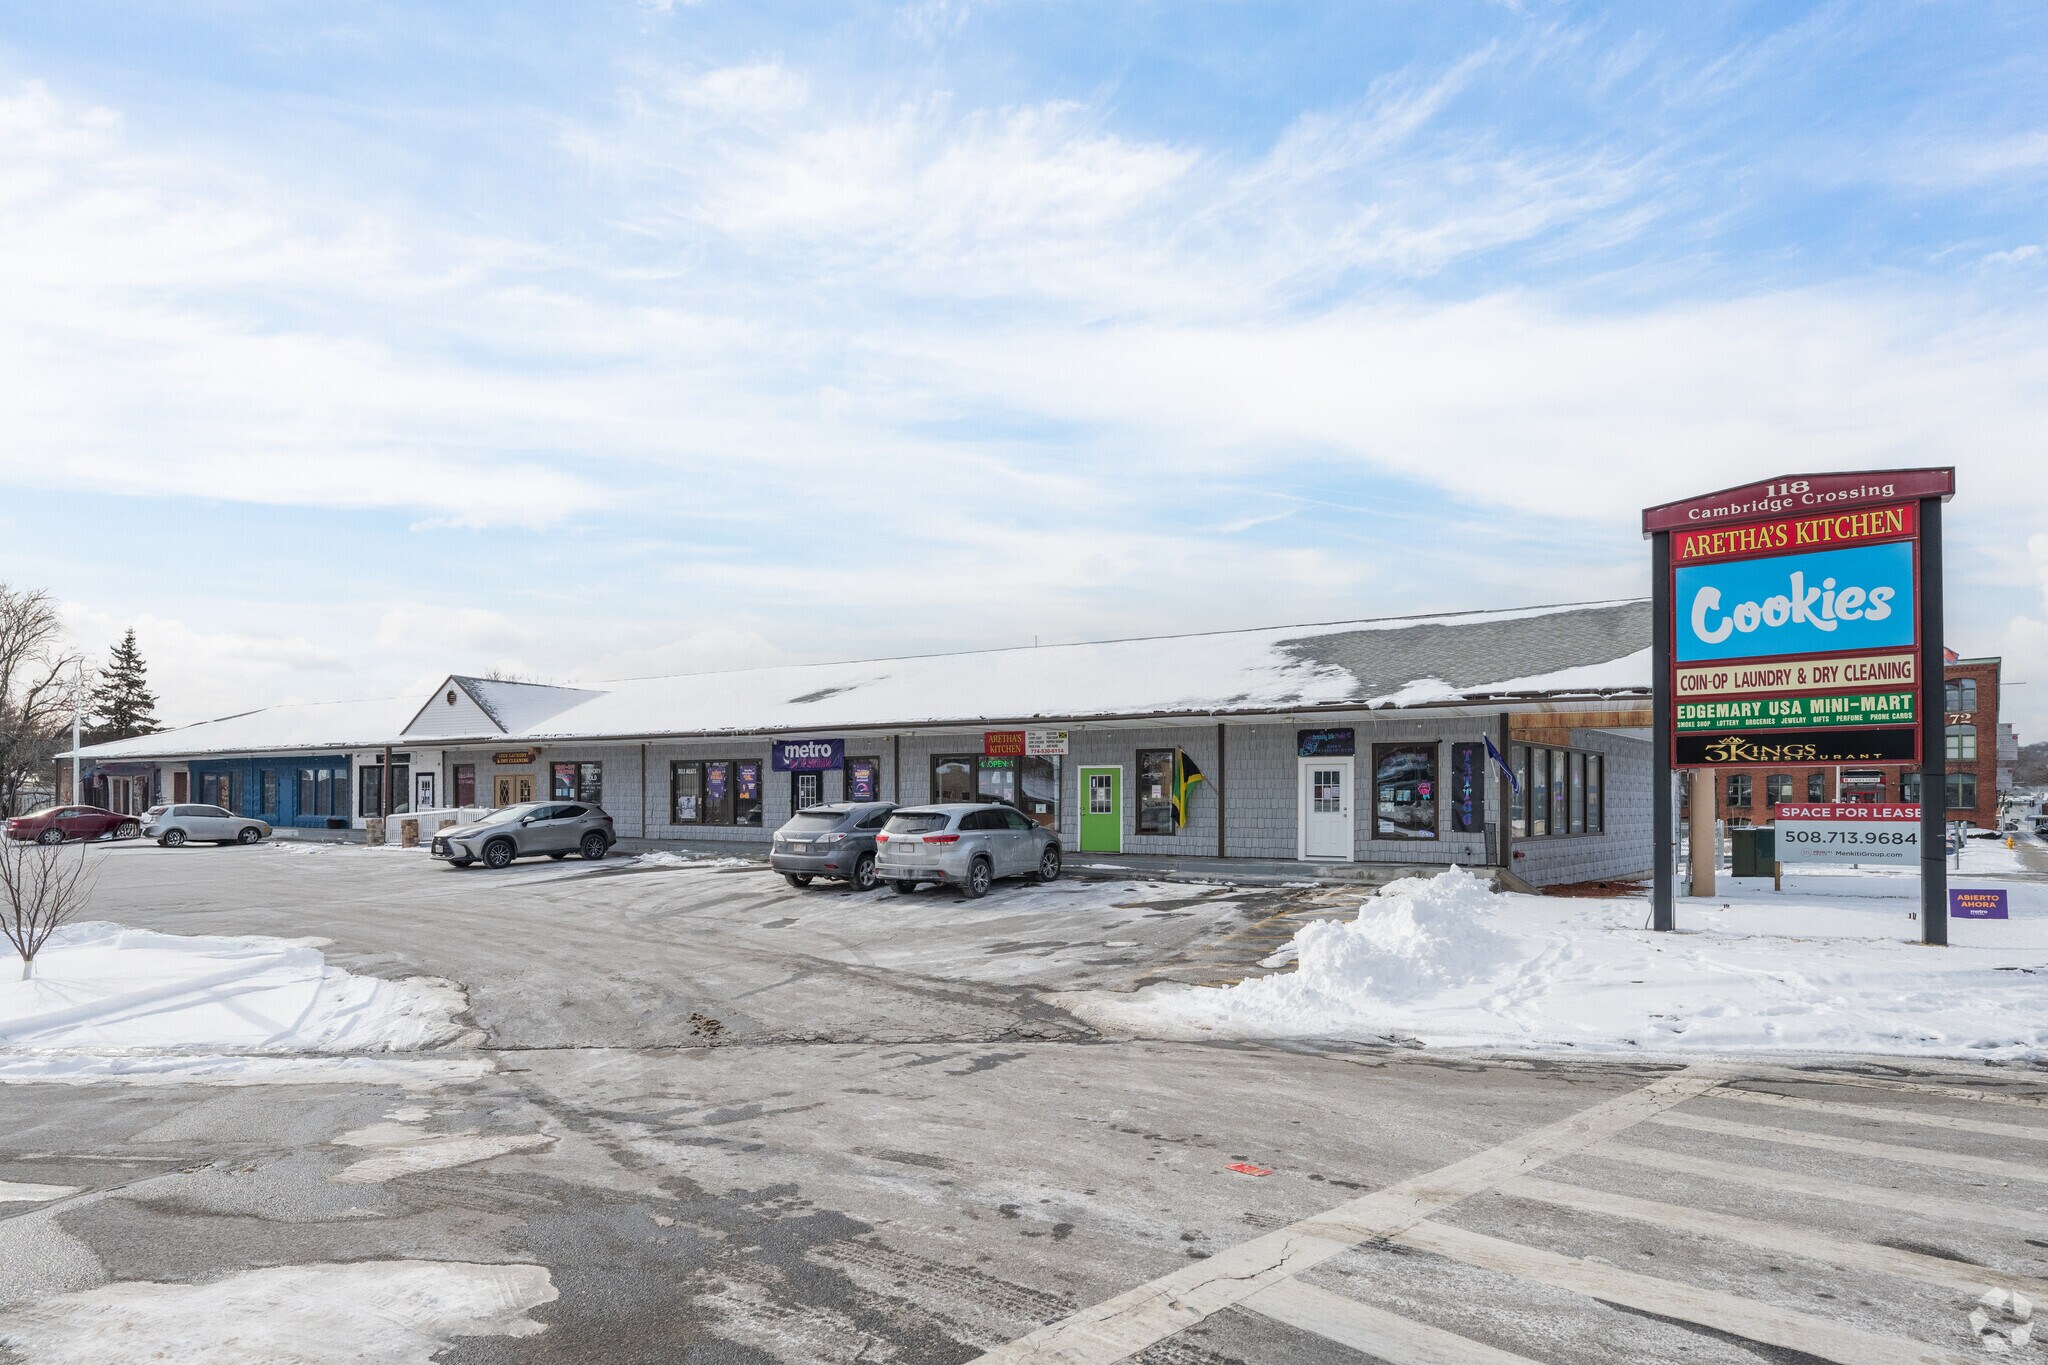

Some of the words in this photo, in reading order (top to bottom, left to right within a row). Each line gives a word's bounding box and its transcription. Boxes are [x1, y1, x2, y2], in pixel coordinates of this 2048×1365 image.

[1766, 480, 1811, 498] 118
[1688, 496, 1793, 520] Cambridge
[1802, 483, 1895, 505] Crossing
[1682, 524, 1788, 559] ARETHA'S
[1795, 508, 1904, 544] KITCHEN
[1690, 571, 1896, 644] Cookies
[1680, 672, 1728, 692] COIN-OP
[1734, 668, 1792, 689] LAUNDRY
[1797, 667, 1807, 685] &
[1812, 665, 1839, 684] DRY
[1844, 660, 1912, 683] CLEANING
[1677, 702, 1761, 720] EDGEMARY
[1769, 700, 1800, 717] USA
[1810, 695, 1913, 715] MINI-MART
[1716, 719, 1739, 727] LOTTERY
[1745, 718, 1775, 726] GROCERIES
[1781, 716, 1806, 724] JEWELRY
[1813, 715, 1830, 723] GIFTS
[1836, 714, 1863, 722] PERFUME
[1870, 713, 1890, 721] PHONE
[1892, 712, 1913, 720] CARDS
[1949, 713, 1972, 725] 72
[988, 734, 1022, 743] ARETHA'S
[784, 741, 832, 758] metro
[989, 744, 1021, 754] KITCHEN
[987, 760, 1007, 768] OPEN
[1760, 753, 1883, 762] RESTAURANT
[1782, 807, 1831, 818] SPACE
[1836, 807, 1868, 818] FOR
[1873, 808, 1921, 818] LEASE
[1785, 830, 1918, 845] 508.713.9684
[1836, 850, 1903, 858] MenkitiGroup.com
